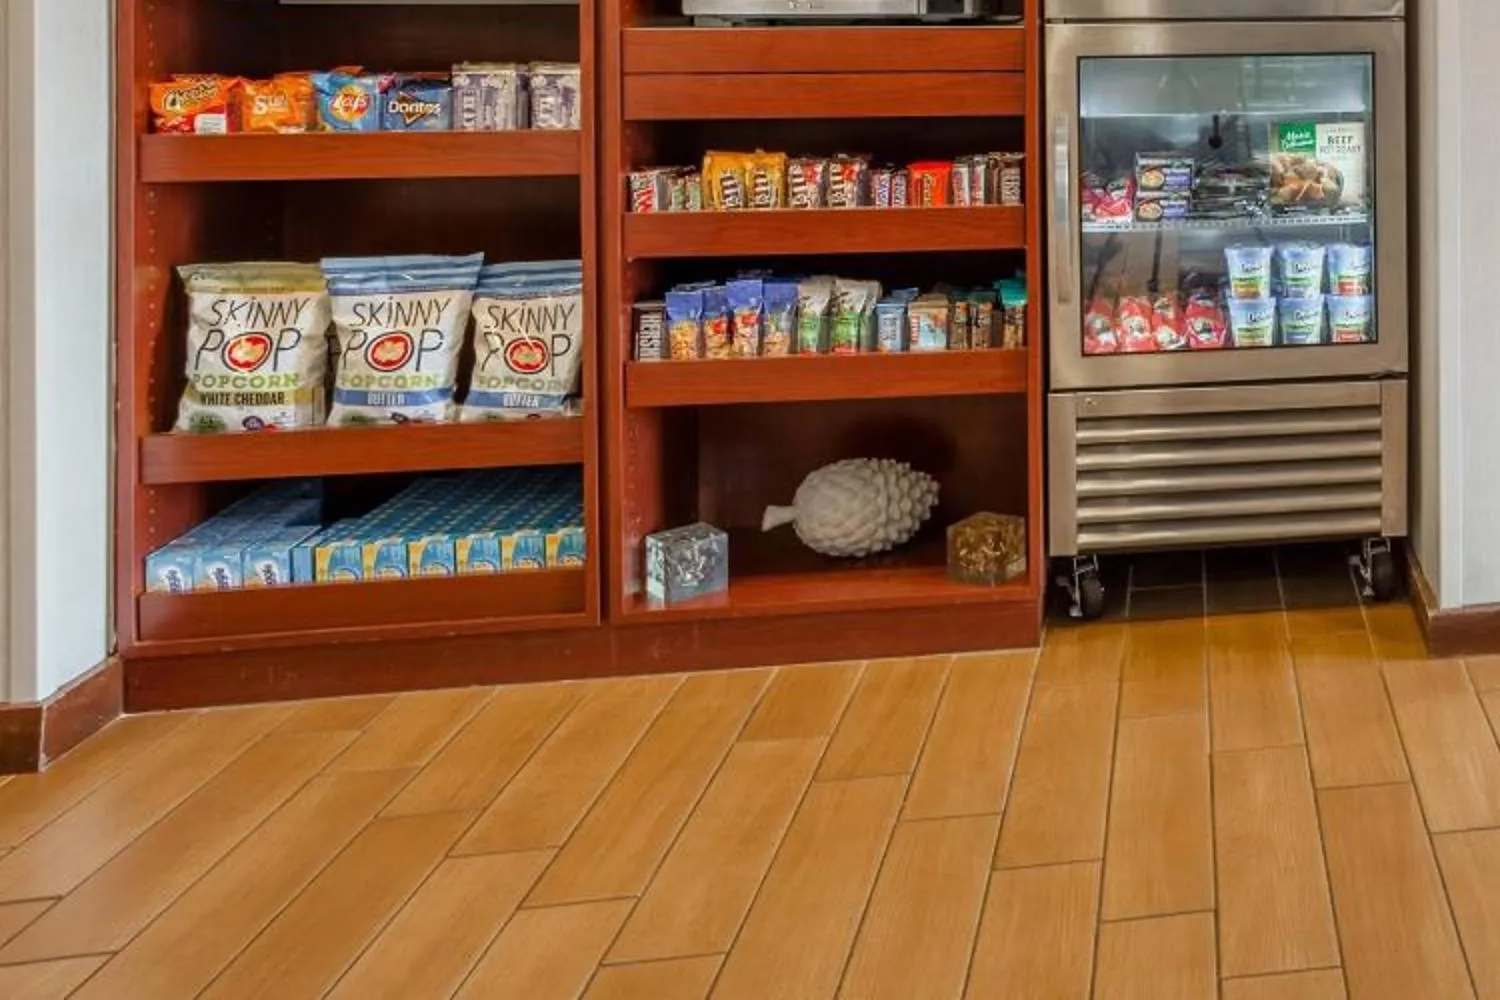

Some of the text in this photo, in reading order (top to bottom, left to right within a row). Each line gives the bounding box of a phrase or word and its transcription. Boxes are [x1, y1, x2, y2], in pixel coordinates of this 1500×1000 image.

[387, 100, 441, 117] Doritos
[195, 327, 303, 373] POP
[343, 328, 445, 372] POP
[480, 333, 573, 377] POP
[193, 373, 299, 389] POPCORN
[201, 391, 286, 406] WHITE CHEDDAR
